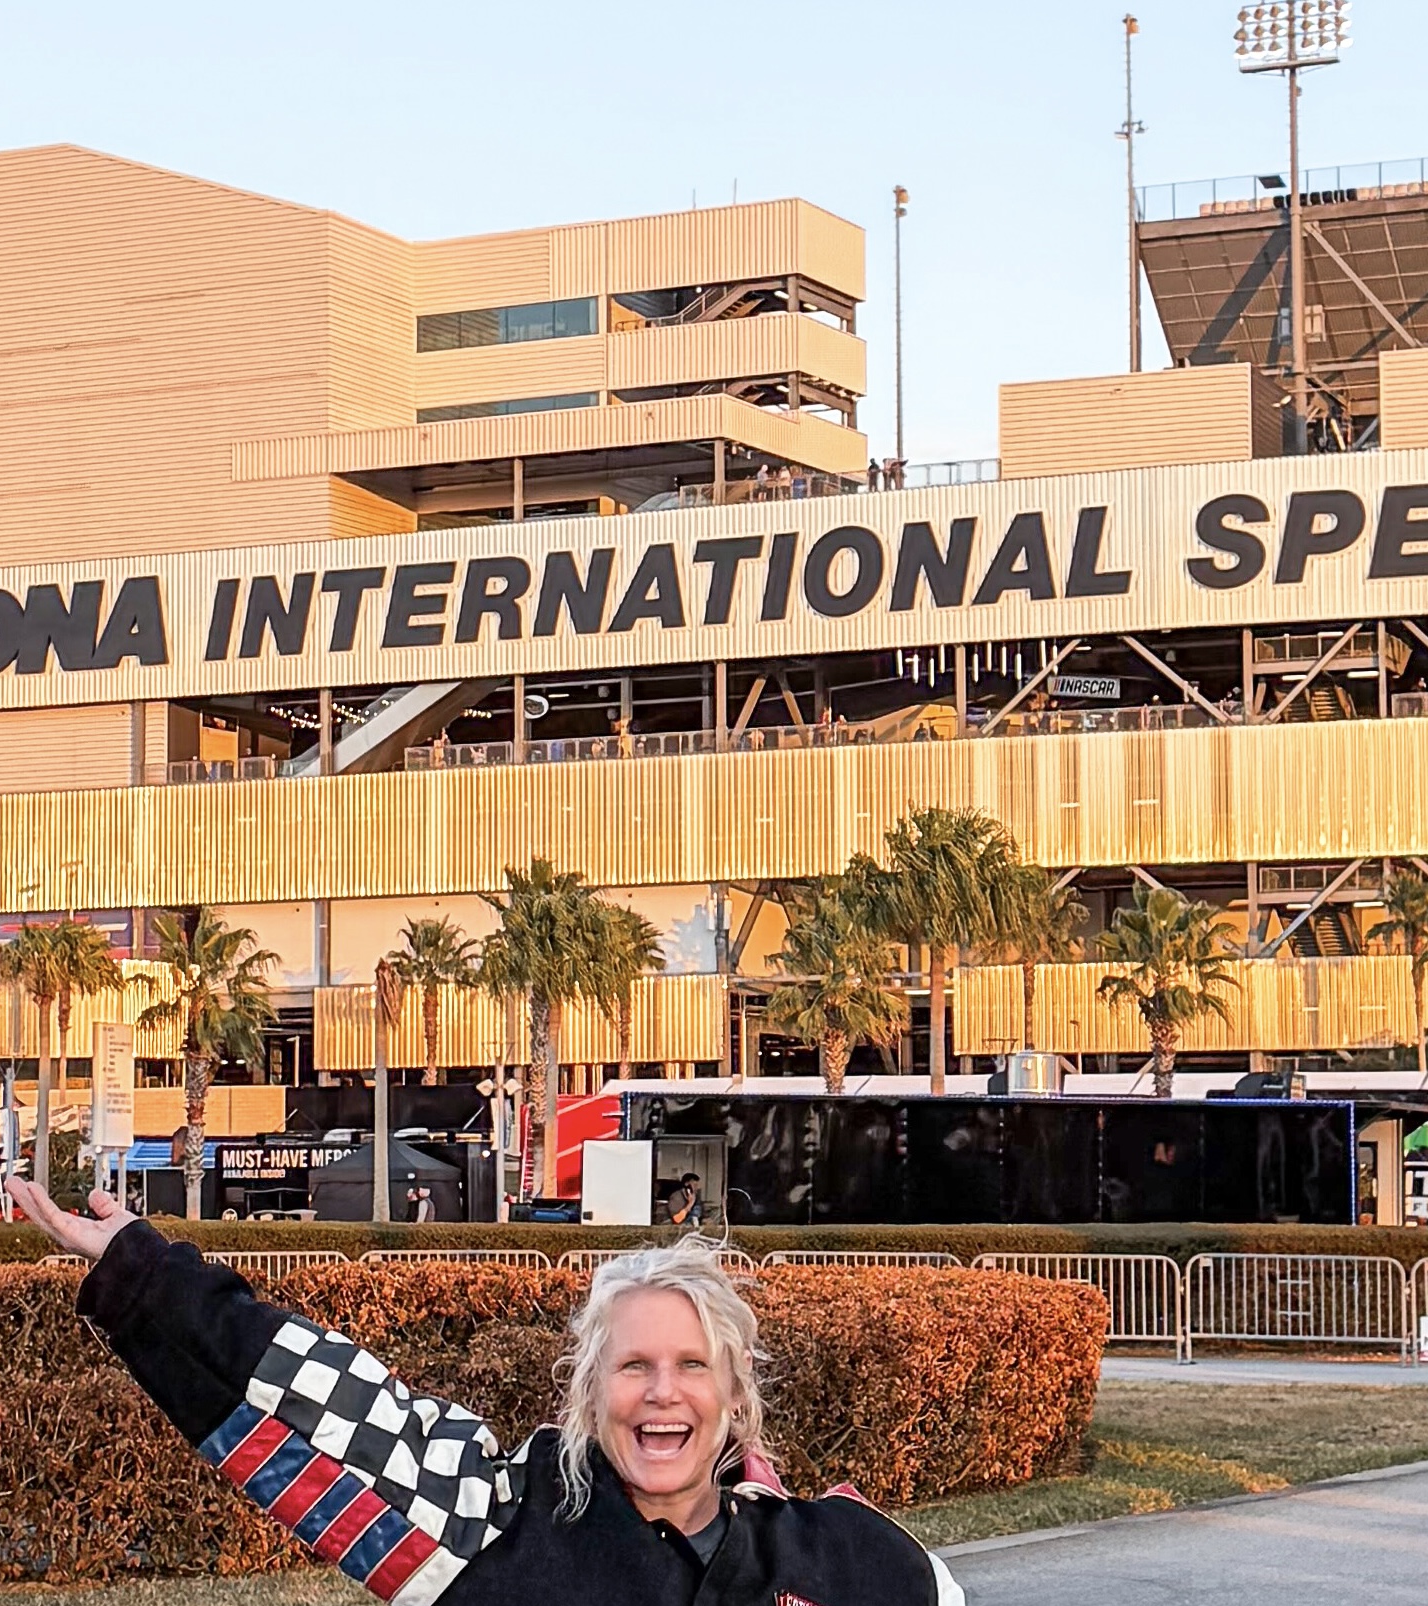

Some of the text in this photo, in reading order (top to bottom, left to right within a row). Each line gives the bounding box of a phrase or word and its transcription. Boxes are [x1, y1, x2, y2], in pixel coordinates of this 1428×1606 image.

[204, 505, 1133, 663] INTERNATIONAL
[1065, 678, 1115, 695] NASCAR
[223, 1149, 358, 1169] MUST-HAVE MER
